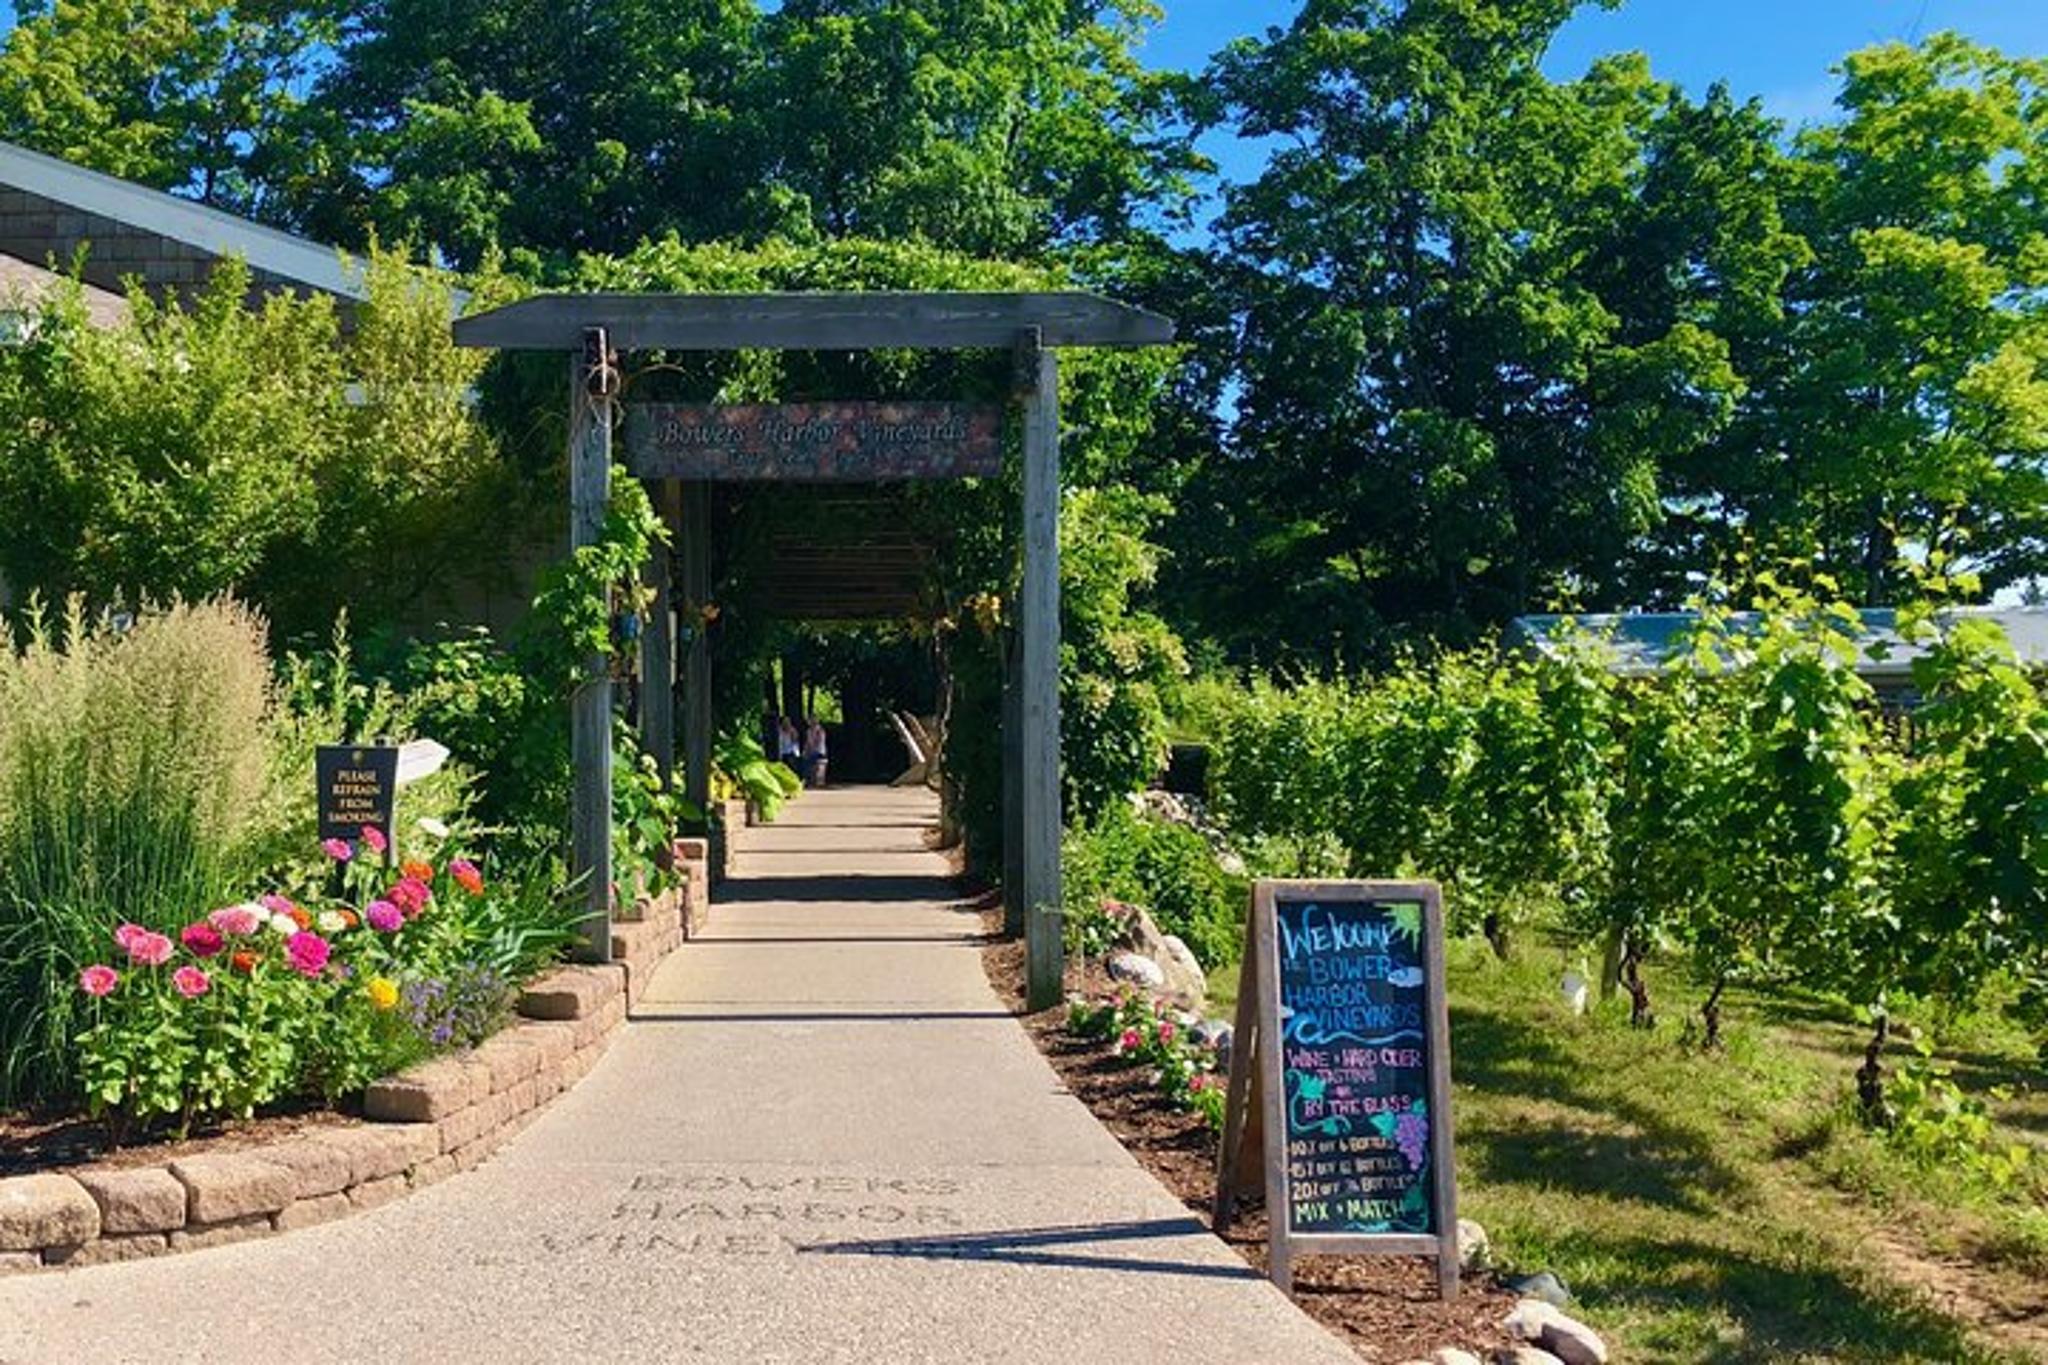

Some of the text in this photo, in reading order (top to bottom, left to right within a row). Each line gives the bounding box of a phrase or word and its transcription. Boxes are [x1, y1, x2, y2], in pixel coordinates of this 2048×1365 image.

[659, 413, 966, 448] Bowers Harbor Vineyards
[338, 770, 376, 782] PLEASE
[332, 783, 380, 795] REFRAIN
[340, 798, 373, 809] FROM
[328, 811, 384, 823] SMOKING
[1286, 982, 1371, 1008] HARBOR
[1287, 1048, 1422, 1067] WINE HARD CIDER
[1316, 1068, 1377, 1084] TASTING
[1304, 1094, 1411, 1118] BY THE GLASS
[1295, 1199, 1406, 1223] MIX MATCH
